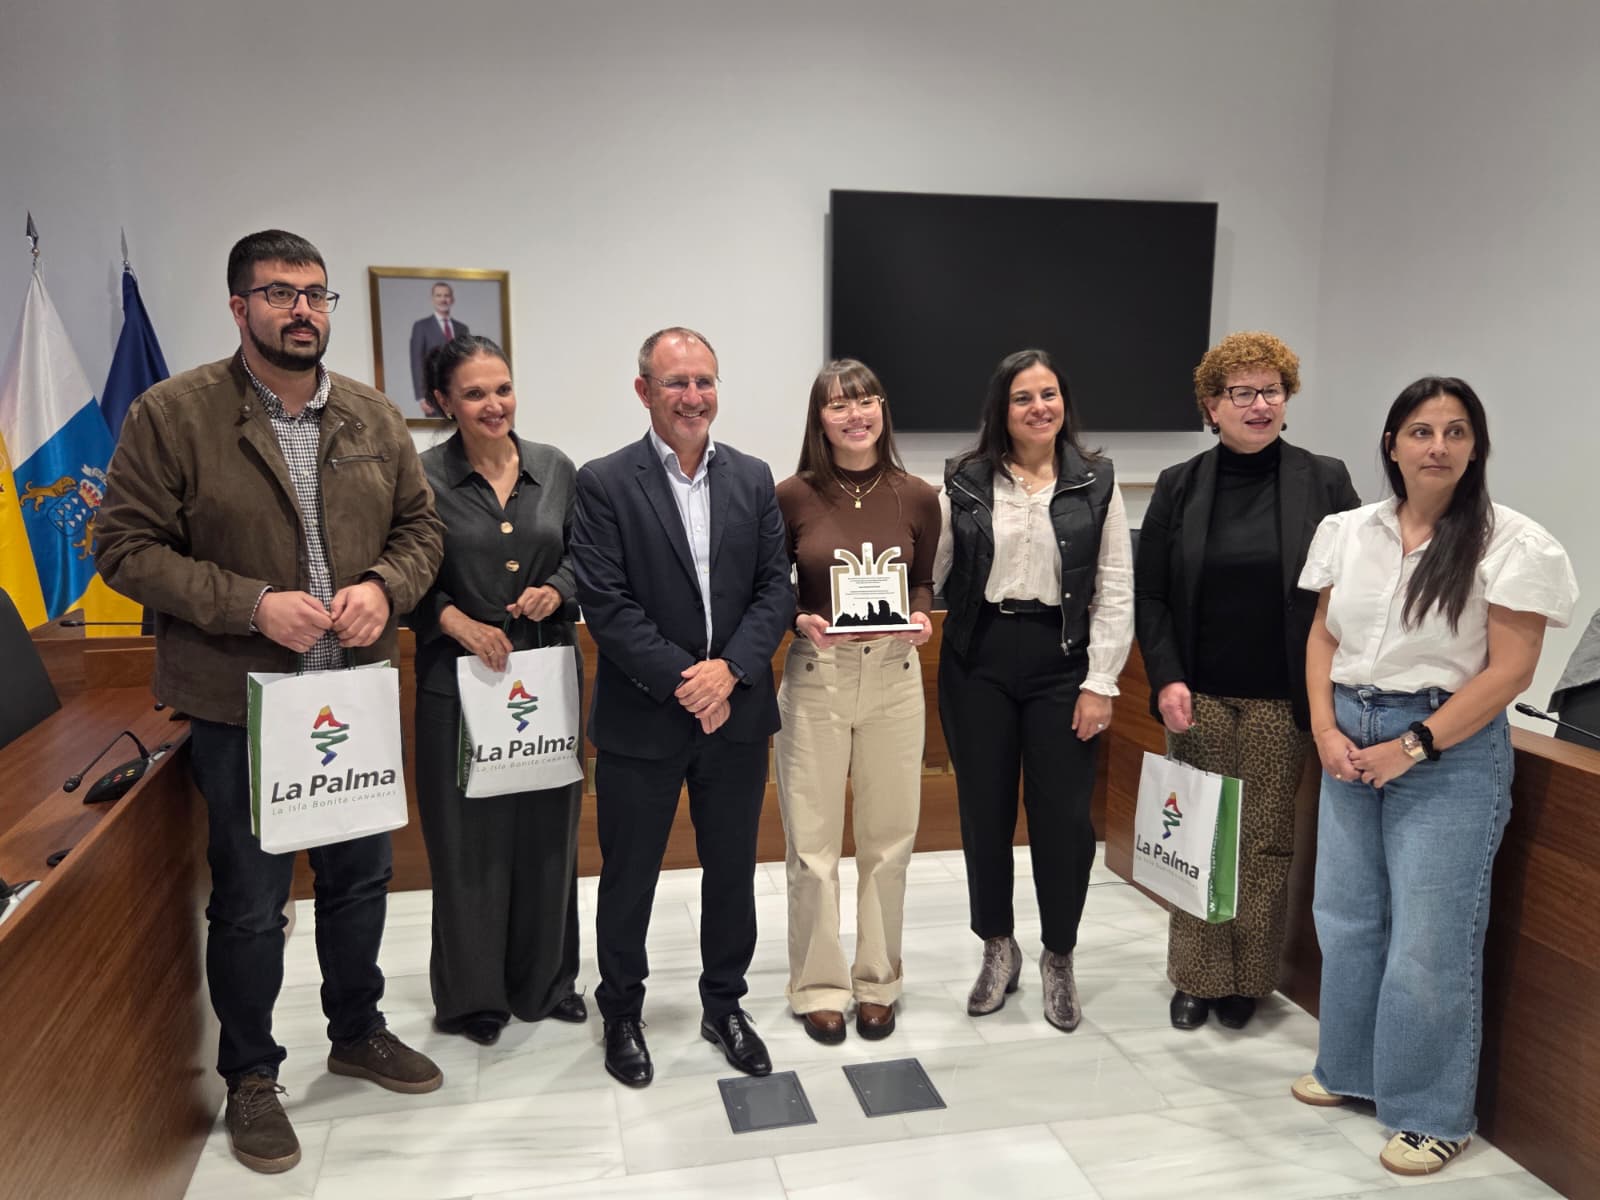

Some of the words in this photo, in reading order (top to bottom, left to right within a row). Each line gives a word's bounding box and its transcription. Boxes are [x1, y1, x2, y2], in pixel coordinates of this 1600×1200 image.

[476, 744, 502, 762] La
[508, 734, 575, 759] Palma
[271, 782, 302, 804] La
[309, 768, 396, 797] Palma
[312, 796, 348, 808] Bonita
[1136, 834, 1150, 855] La
[1153, 843, 1200, 880] Palma
